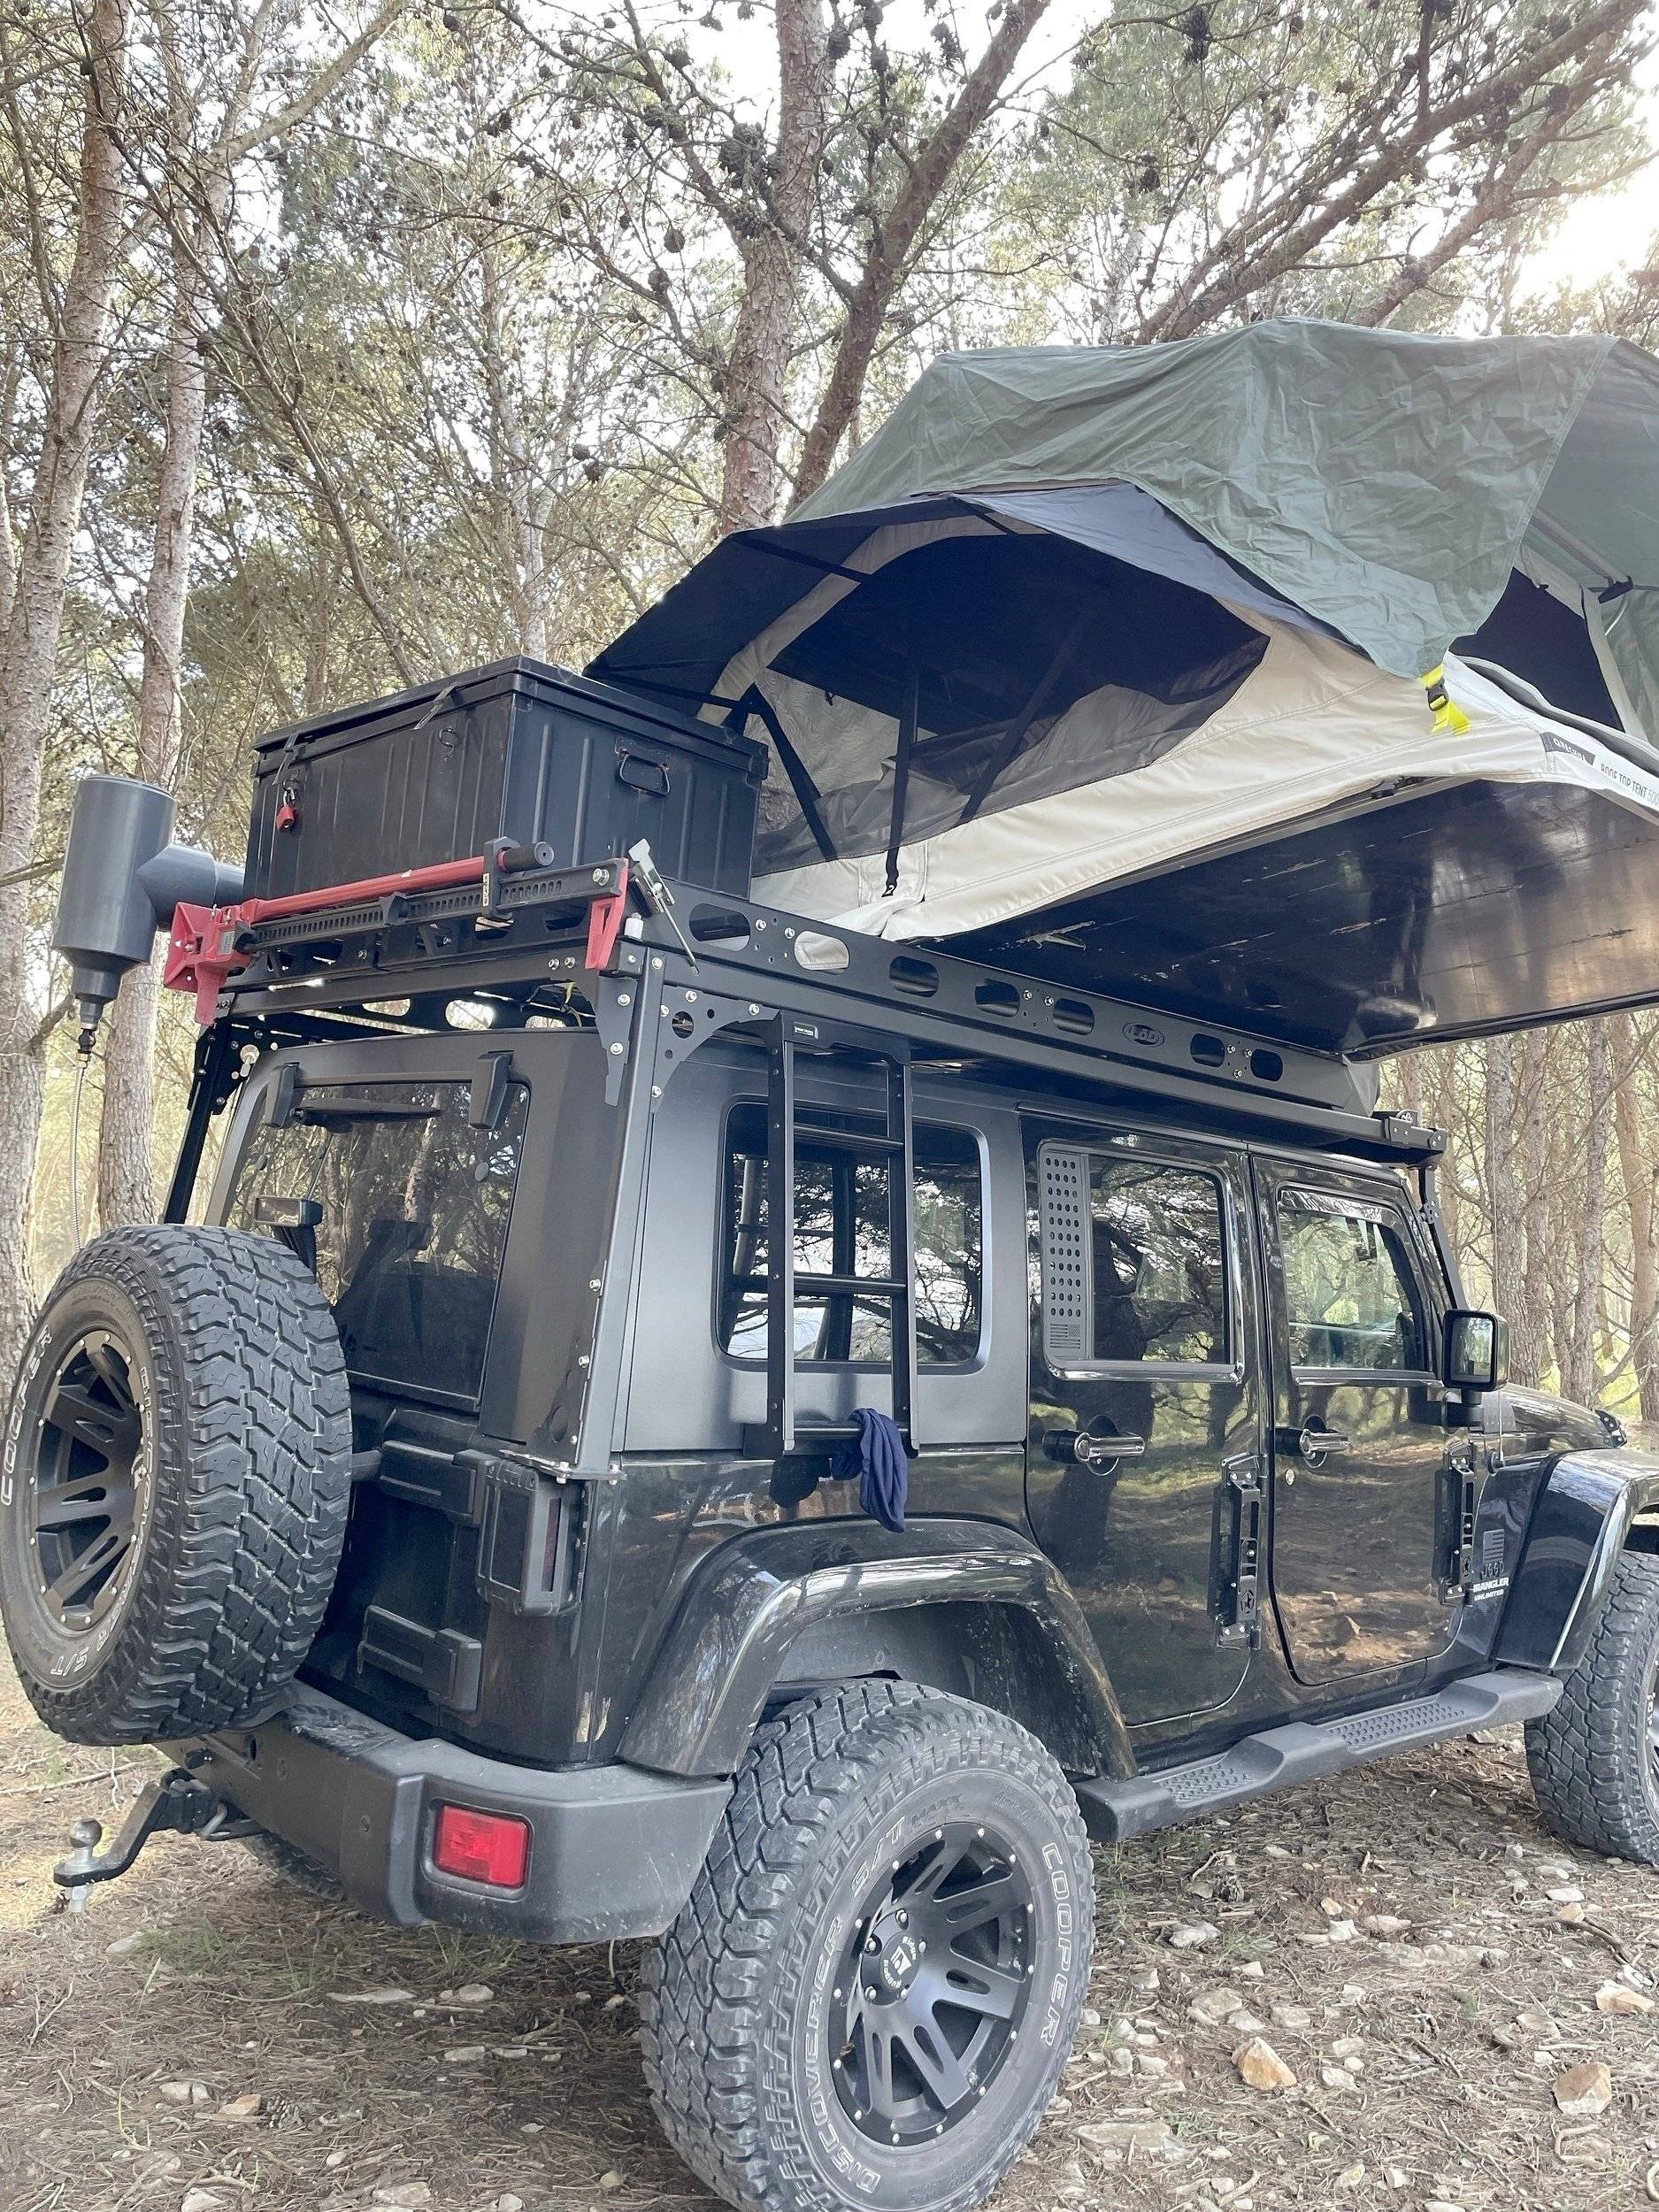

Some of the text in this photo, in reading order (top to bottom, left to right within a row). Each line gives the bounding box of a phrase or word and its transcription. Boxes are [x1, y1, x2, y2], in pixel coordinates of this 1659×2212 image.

[1600, 764, 1618, 780] ROOF
[1618, 773, 1632, 787] TOP
[1632, 780, 1648, 799] TENT
[1, 1325, 52, 1506] COOPER
[1472, 1577, 1509, 1593] RANGLER
[50, 1646, 89, 1677] S/T
[1041, 1842, 1072, 2047] COOPER
[805, 1816, 905, 2193] DISCOVERER S/T
